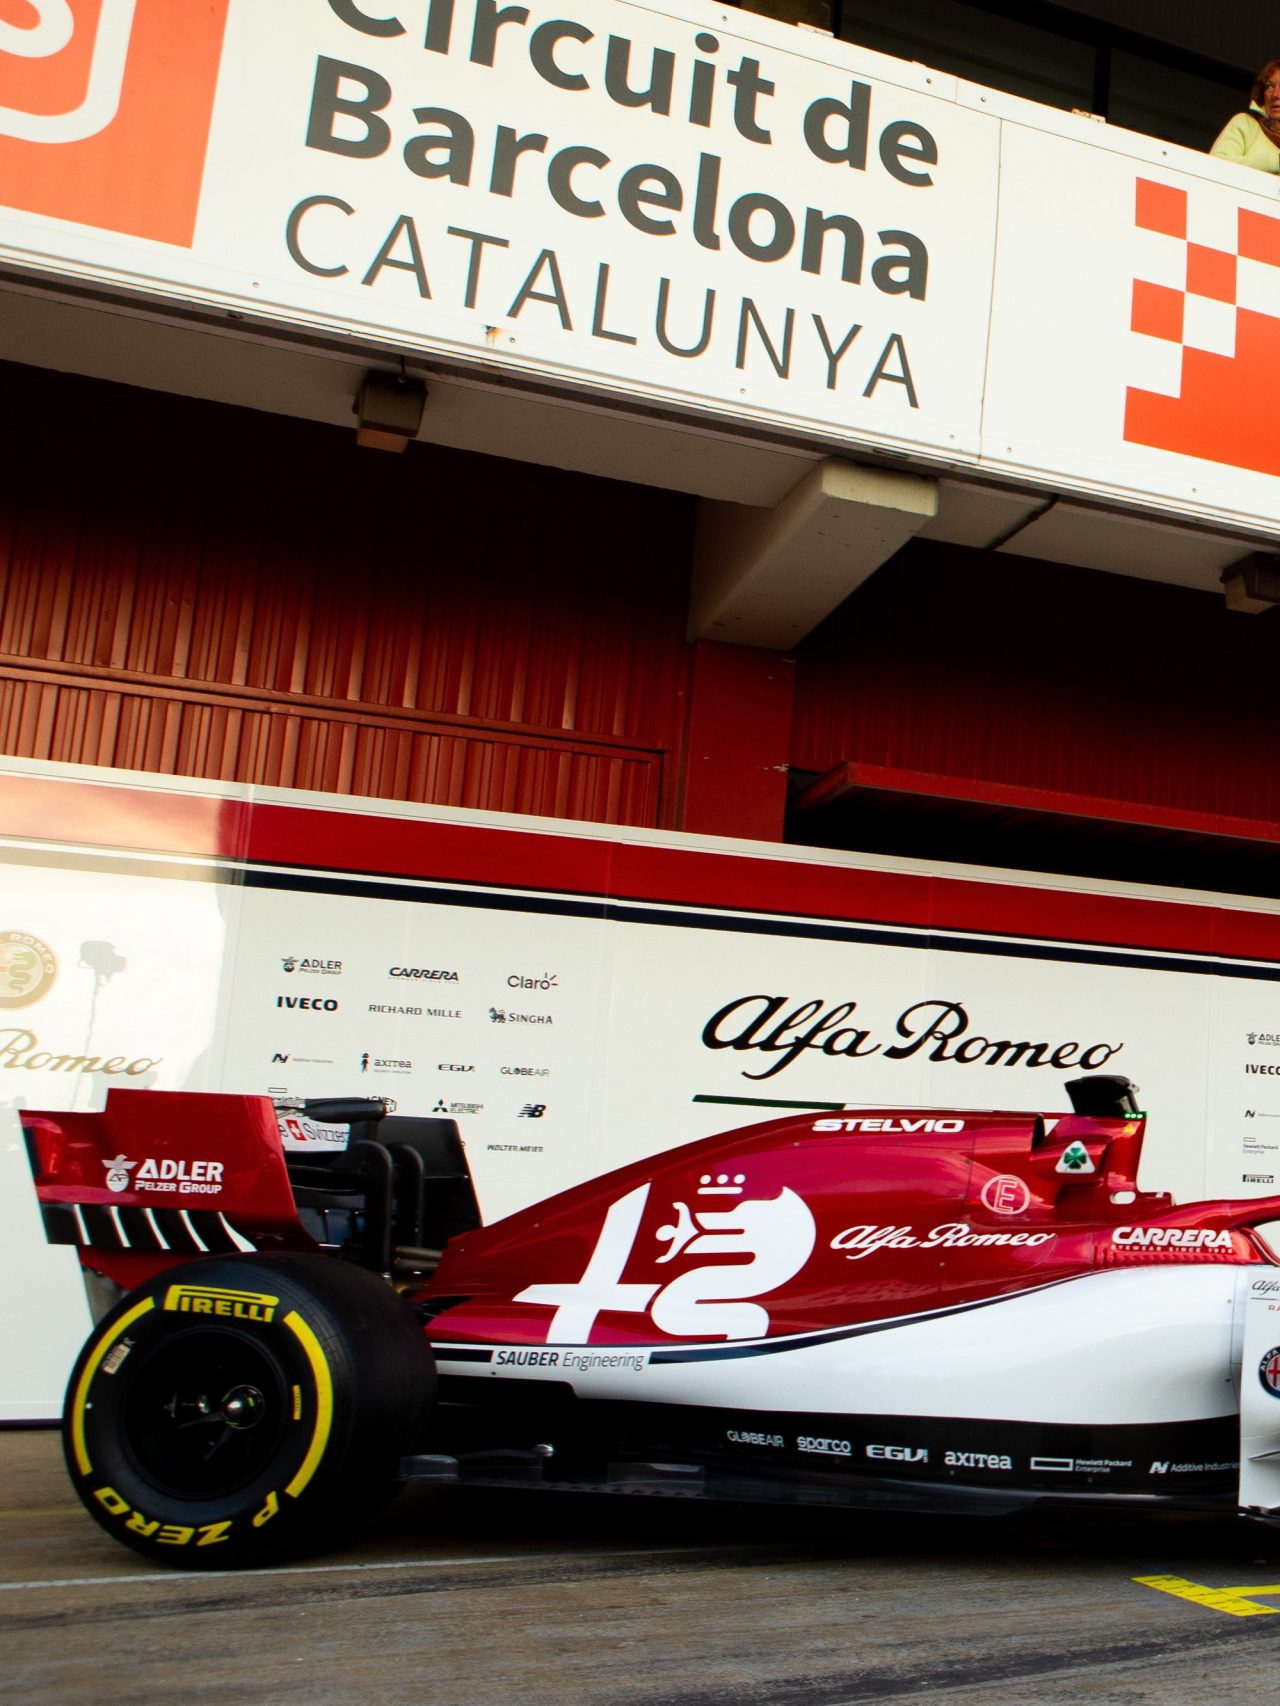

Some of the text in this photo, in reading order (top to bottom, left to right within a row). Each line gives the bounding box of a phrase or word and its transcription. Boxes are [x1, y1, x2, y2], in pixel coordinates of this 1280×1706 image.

[803, 80, 939, 188] de
[305, 55, 930, 302] Barcelona
[285, 195, 920, 409] CATALUNYA
[301, 958, 343, 970] ADLER
[390, 967, 459, 981] CARRERA
[507, 974, 552, 990] Claro
[277, 996, 338, 1012] IVECO
[368, 1004, 463, 1018] RICHARD MILLE
[508, 1012, 553, 1024] SINGHA
[702, 994, 1124, 1080] Alfa Romeo
[0, 1028, 163, 1076] Romeo
[501, 1067, 550, 1077] GLOBEAIR
[811, 1119, 966, 1133] STELVIO
[136, 1158, 225, 1183] ADLER
[1243, 1174, 1274, 1183] PIRELLI
[134, 1180, 223, 1194] PELZER GROUP
[829, 1223, 1056, 1260] Alfa Romeo
[1111, 1226, 1234, 1248] CARRERA
[1252, 1280, 1280, 1295] Alfa
[163, 1284, 279, 1323] PIRELLI
[496, 1351, 645, 1372] SAUBER Engineering
[727, 1430, 785, 1448] GLOBEAIR
[797, 1436, 851, 1455] sparco
[93, 1486, 232, 1547] ZERO
